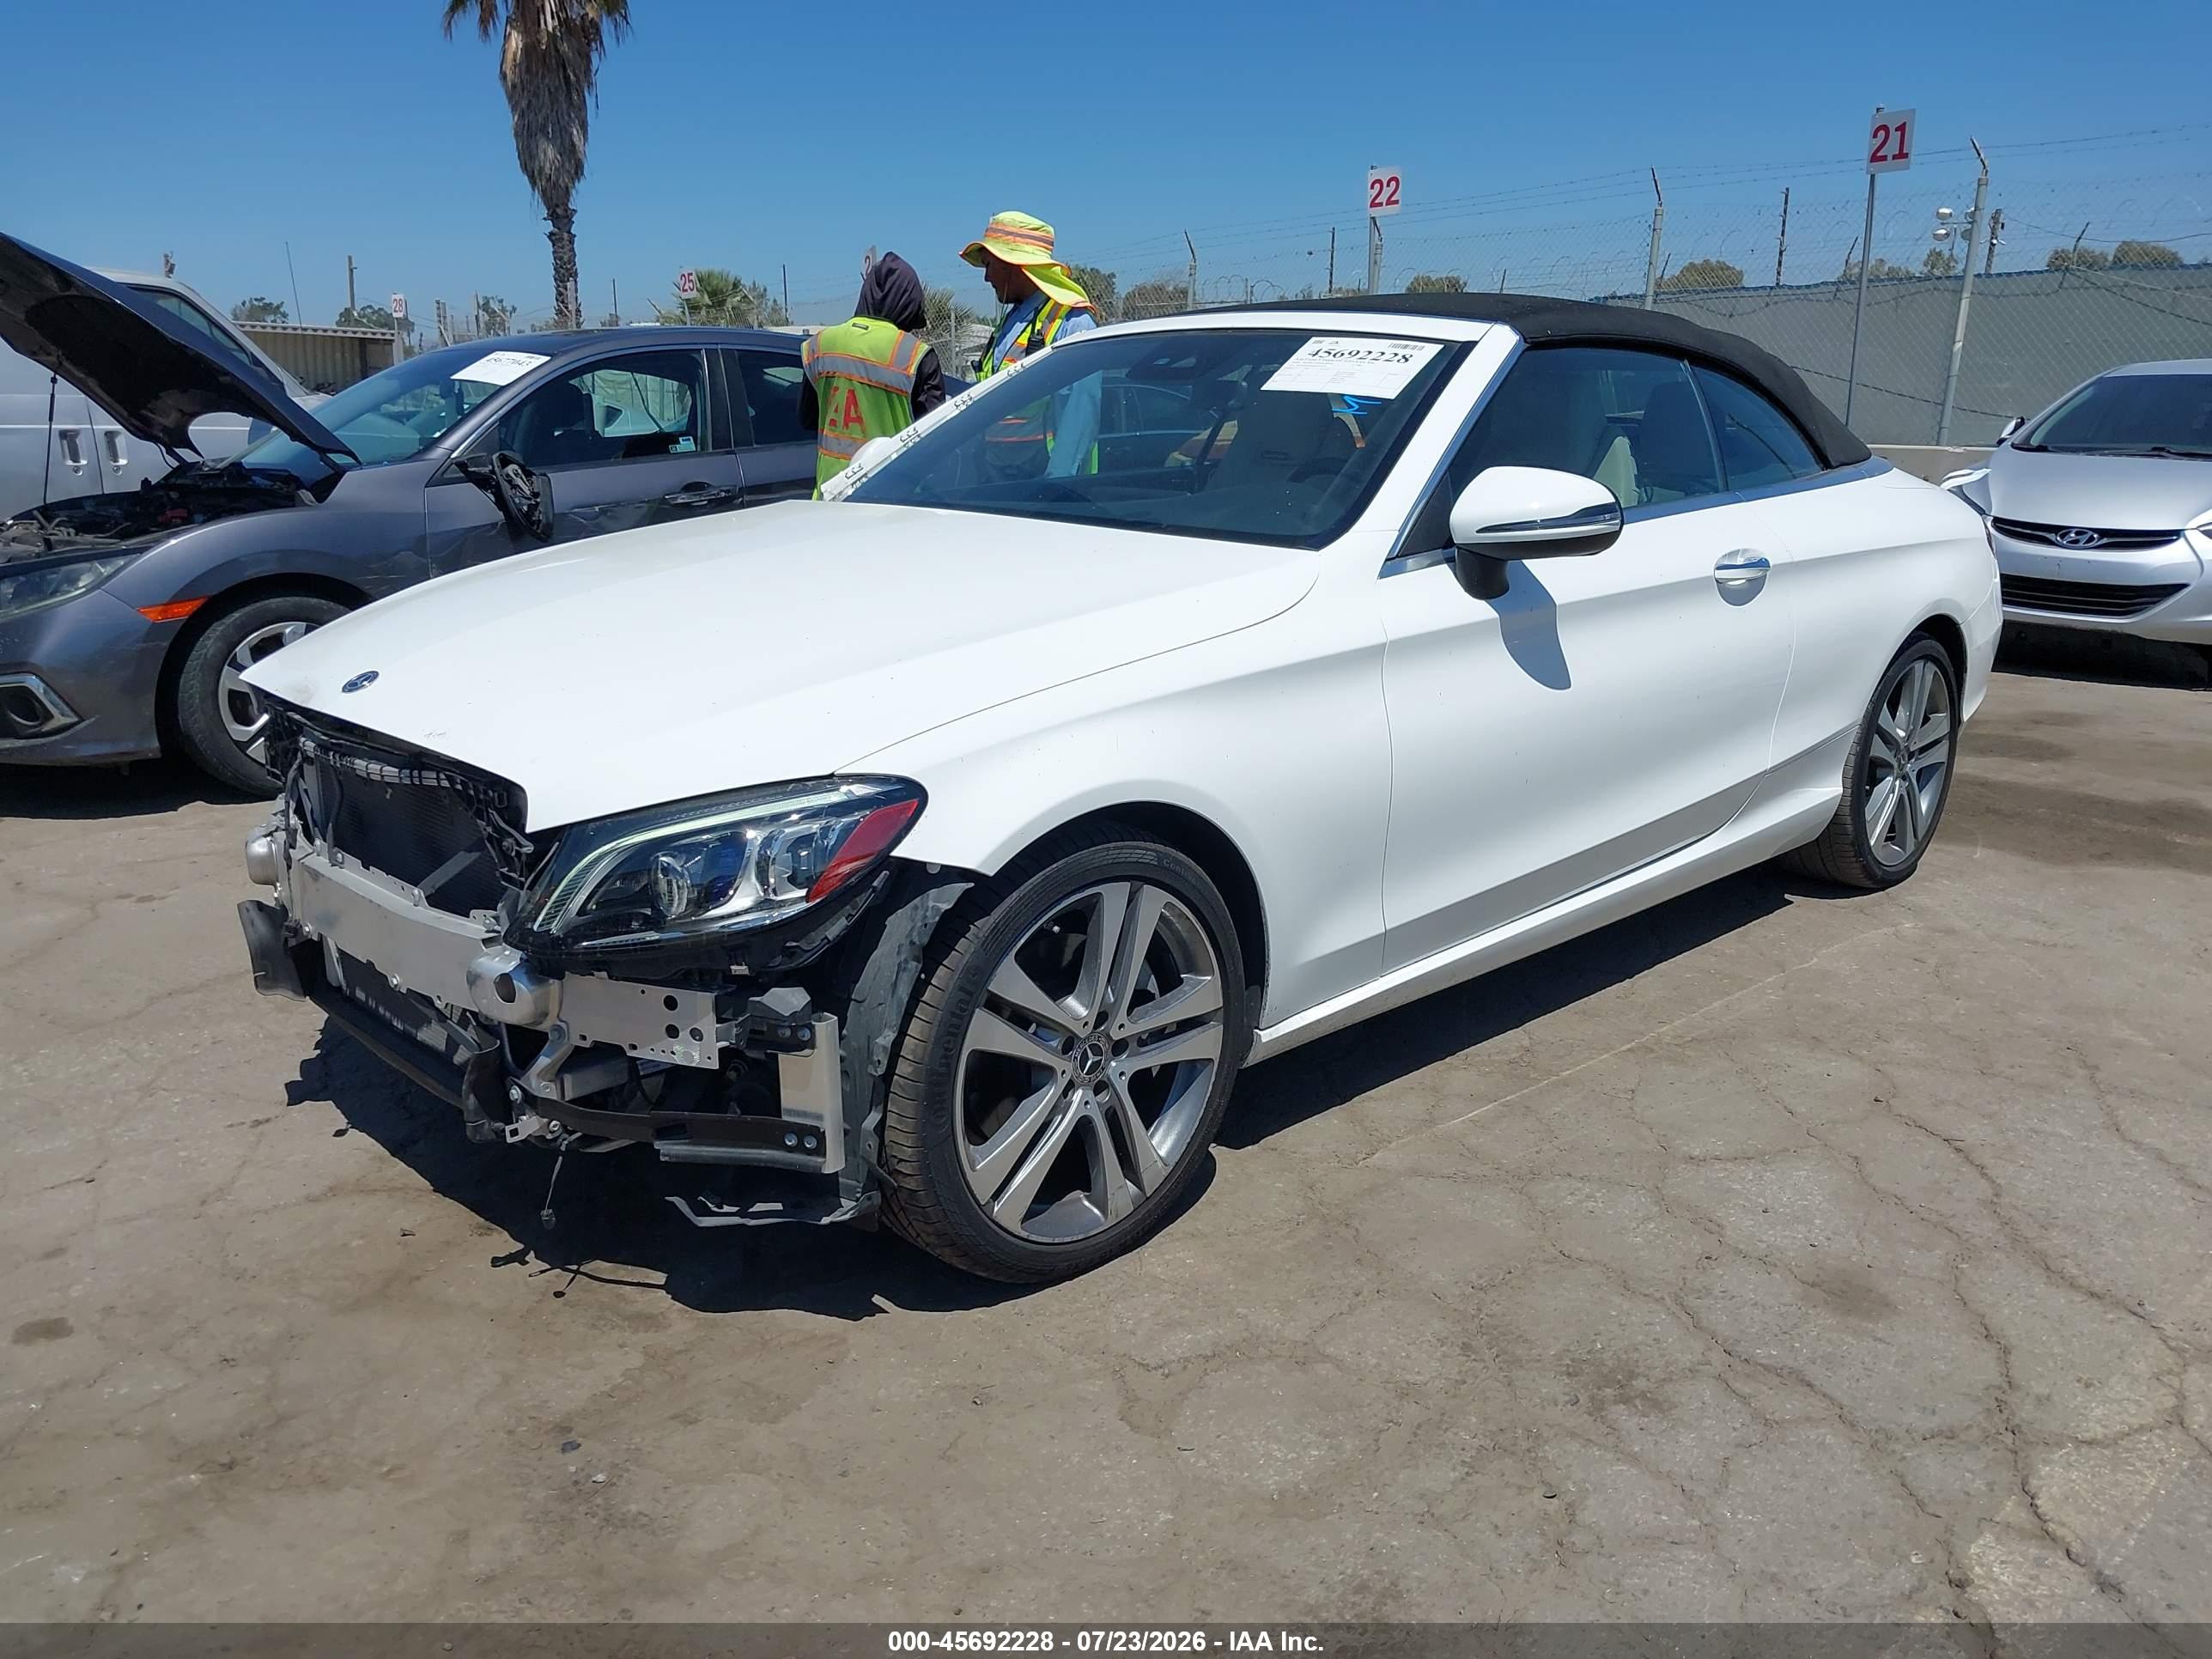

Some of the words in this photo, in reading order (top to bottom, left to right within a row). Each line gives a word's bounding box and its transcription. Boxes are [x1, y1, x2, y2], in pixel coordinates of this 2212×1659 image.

[1869, 121, 1909, 163] 21
[1370, 176, 1400, 208] 22
[680, 272, 695, 292] 25
[392, 298, 404, 313] 28
[1308, 348, 1413, 364] 45692228
